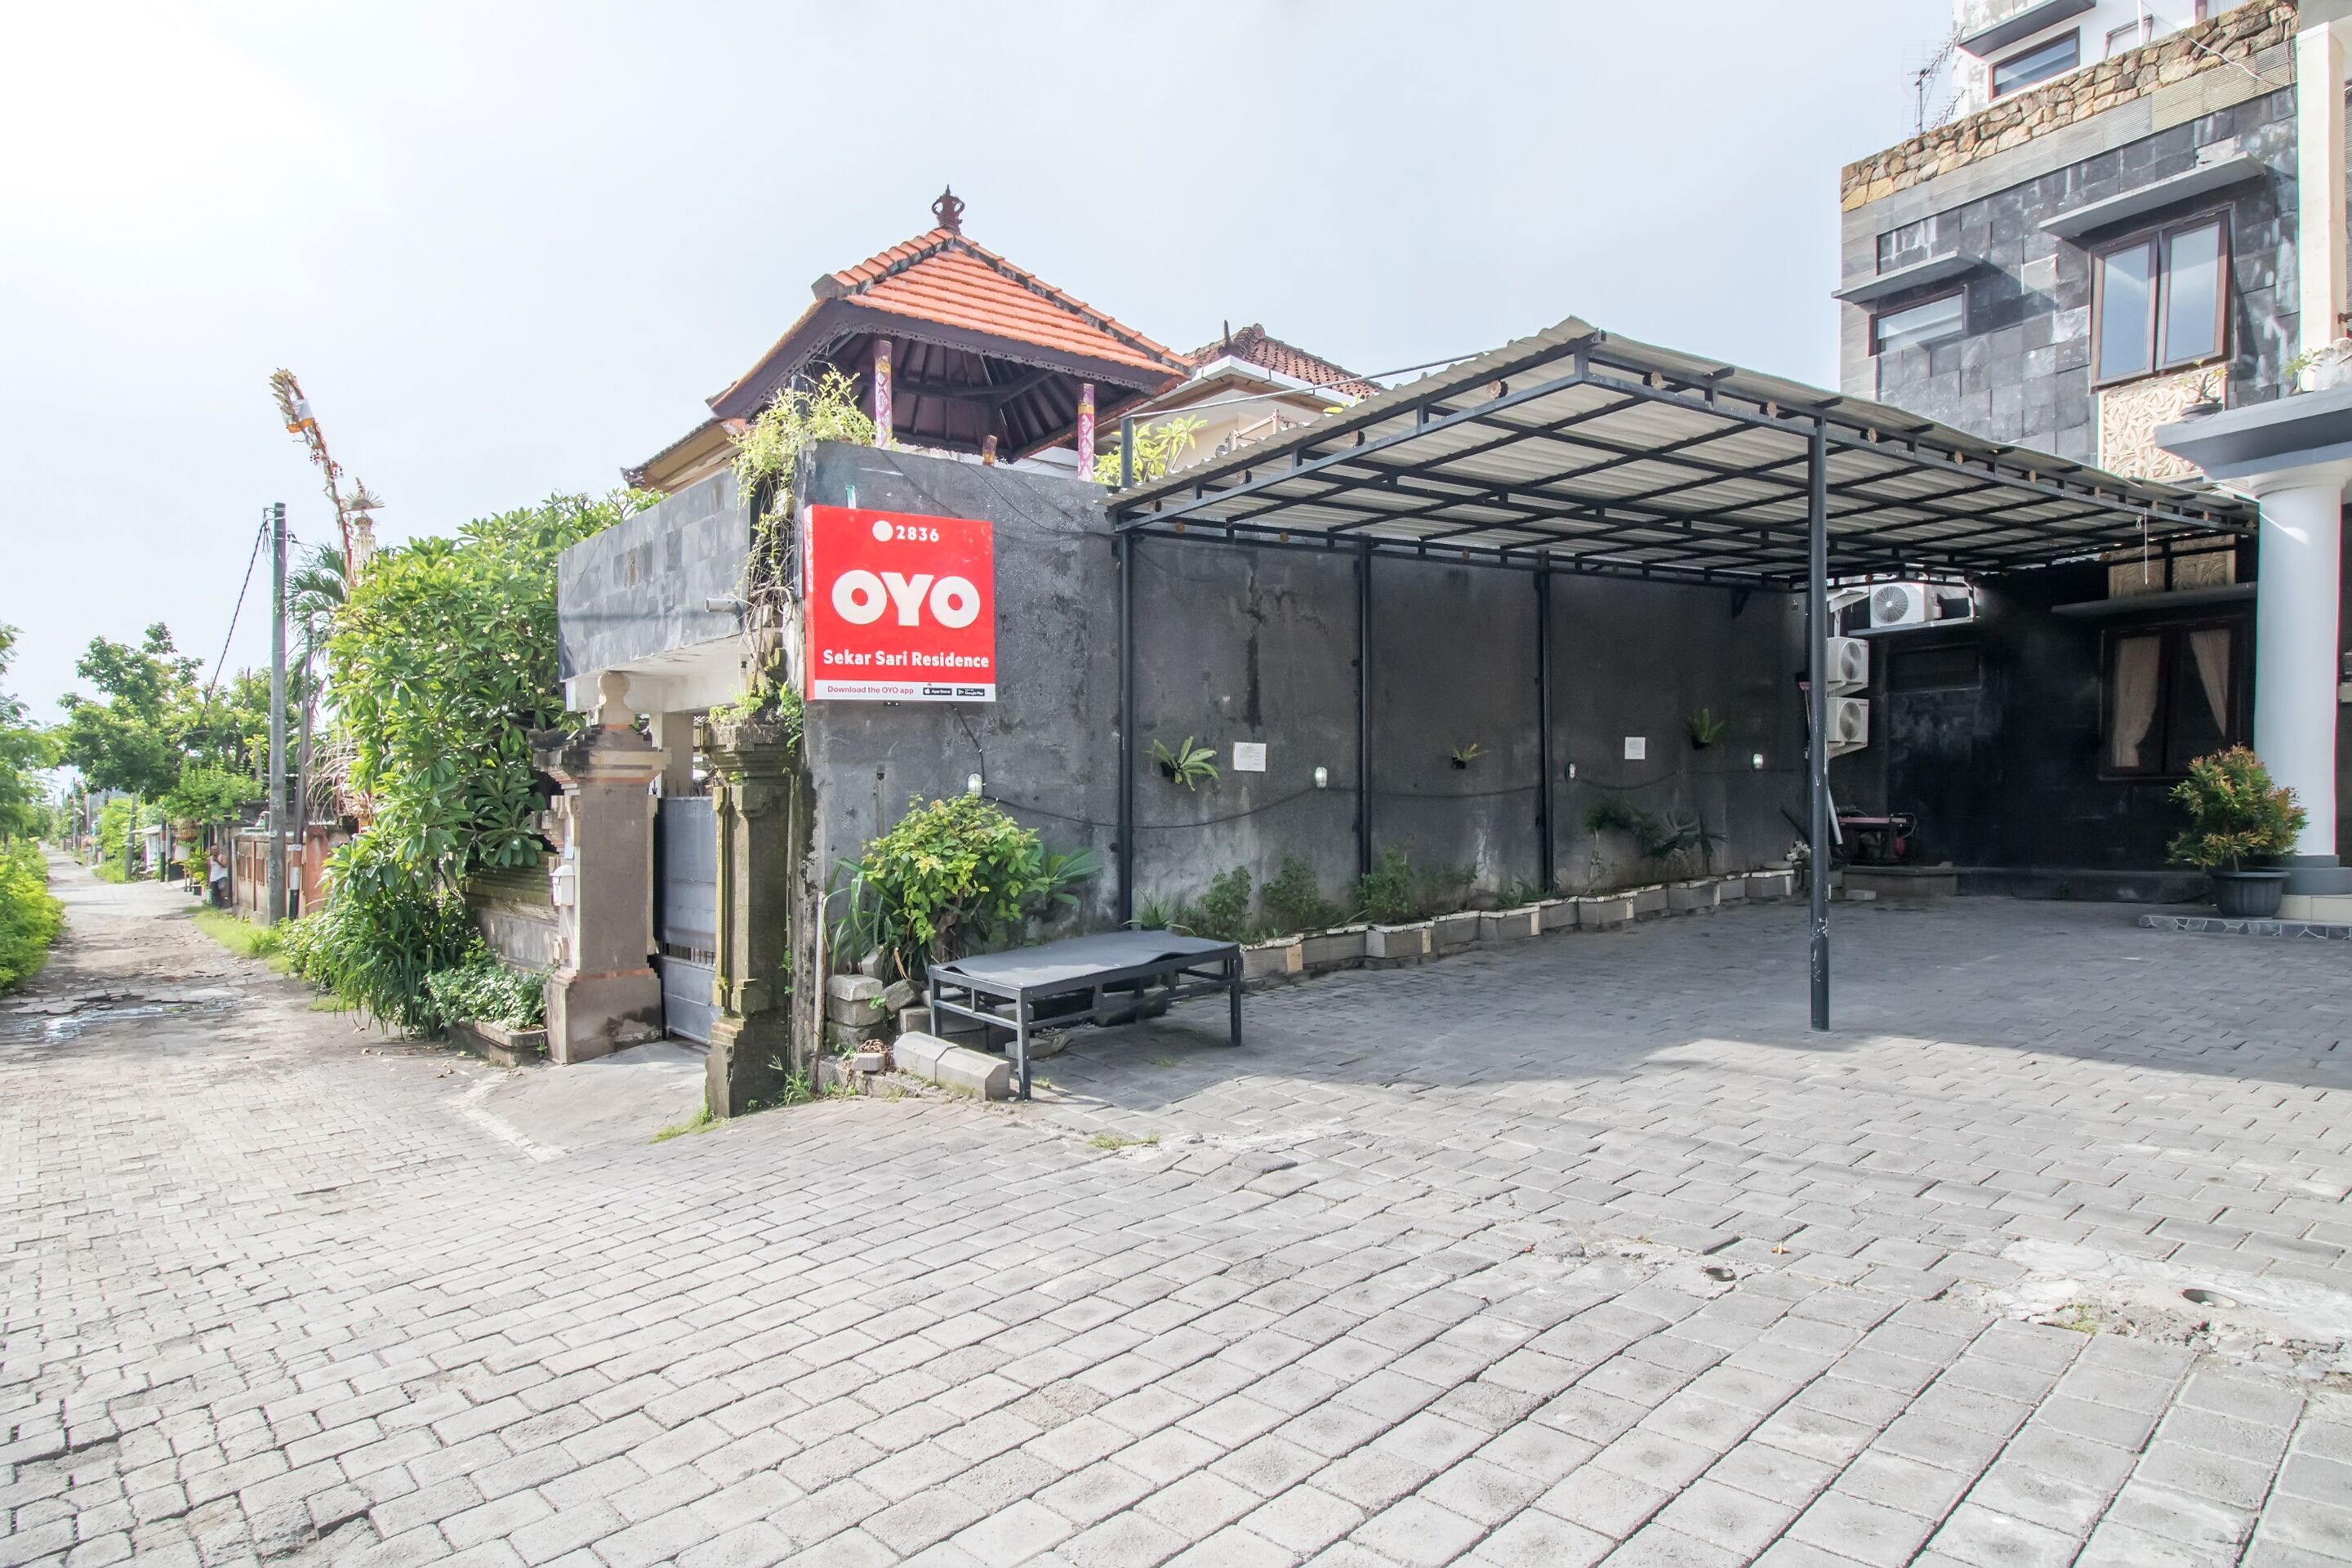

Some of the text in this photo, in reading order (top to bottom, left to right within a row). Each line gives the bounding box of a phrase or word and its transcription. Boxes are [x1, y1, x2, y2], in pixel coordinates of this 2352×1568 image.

[896, 525, 939, 542] 2836
[831, 569, 980, 629] OYO
[823, 649, 989, 668] Sekar Sari Residence
